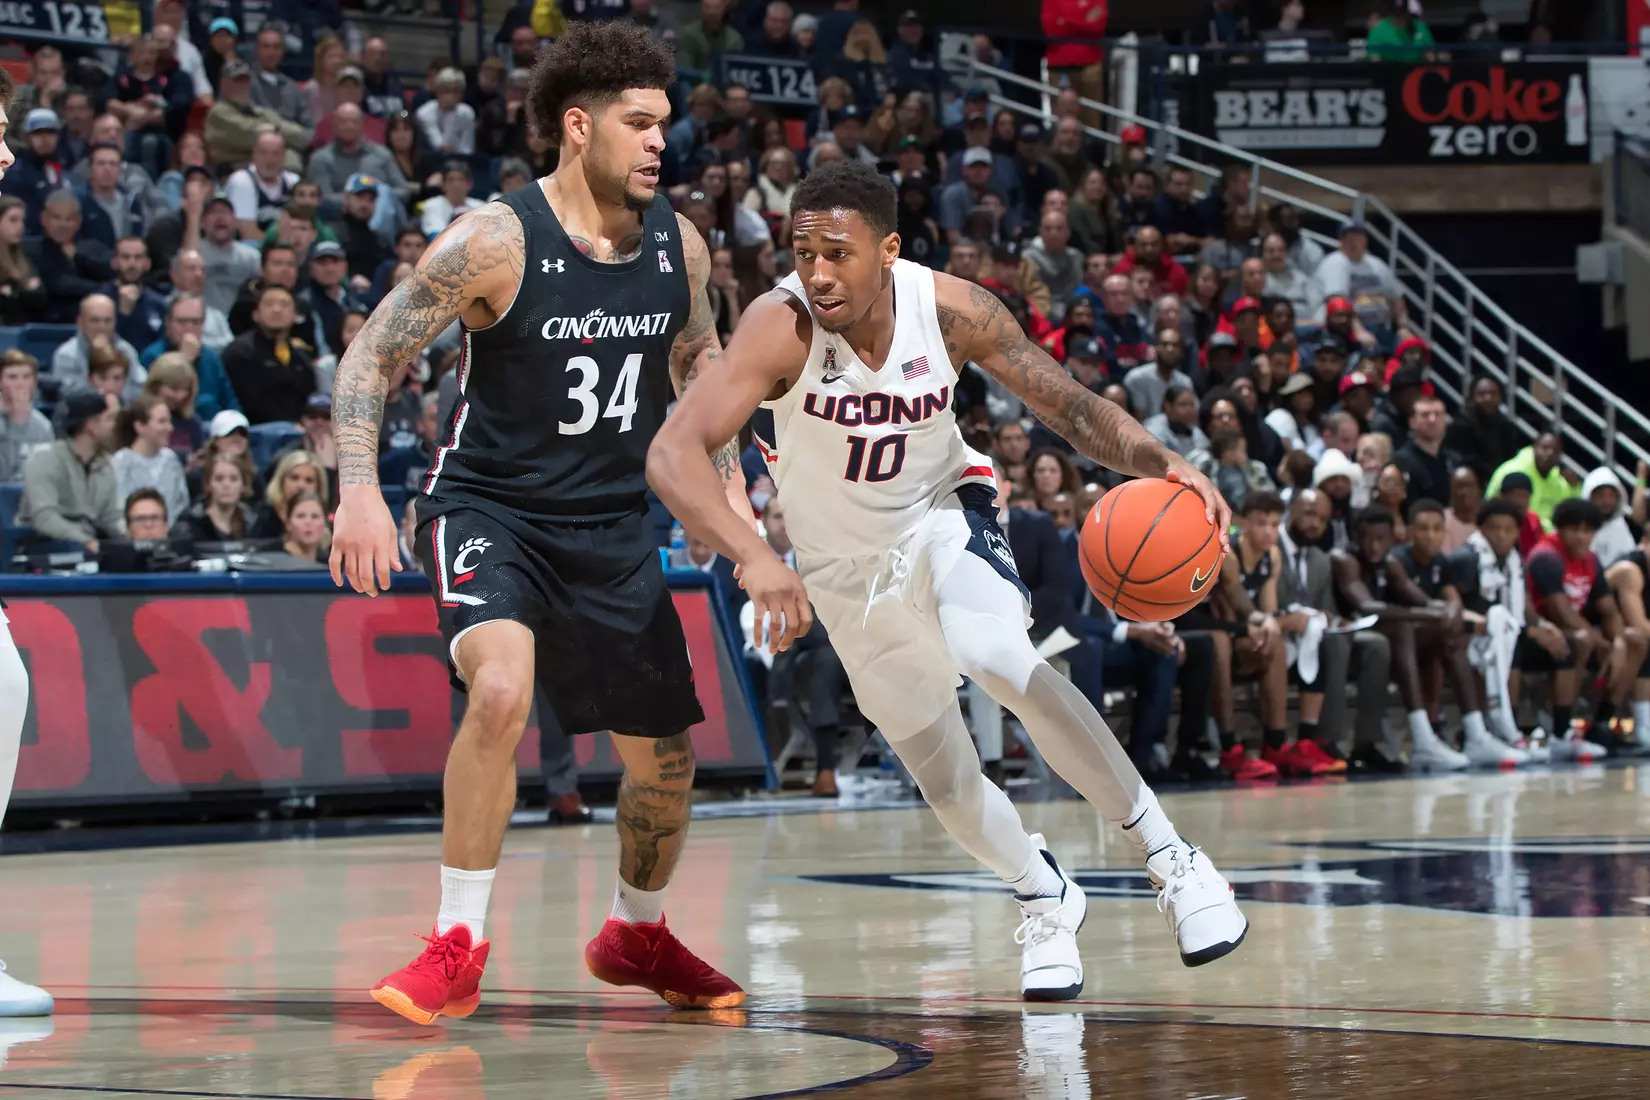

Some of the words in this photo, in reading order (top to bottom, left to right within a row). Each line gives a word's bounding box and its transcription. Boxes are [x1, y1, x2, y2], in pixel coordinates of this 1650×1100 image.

[42, 0, 108, 43] 123
[767, 65, 818, 102] 124
[1402, 65, 1561, 123] Coke
[1213, 88, 1387, 127] BEAR'S
[1428, 124, 1538, 156] zero
[541, 309, 672, 340] CINCINNATI
[558, 353, 644, 435] 34
[803, 385, 949, 427] UCONN
[844, 433, 909, 483] 10
